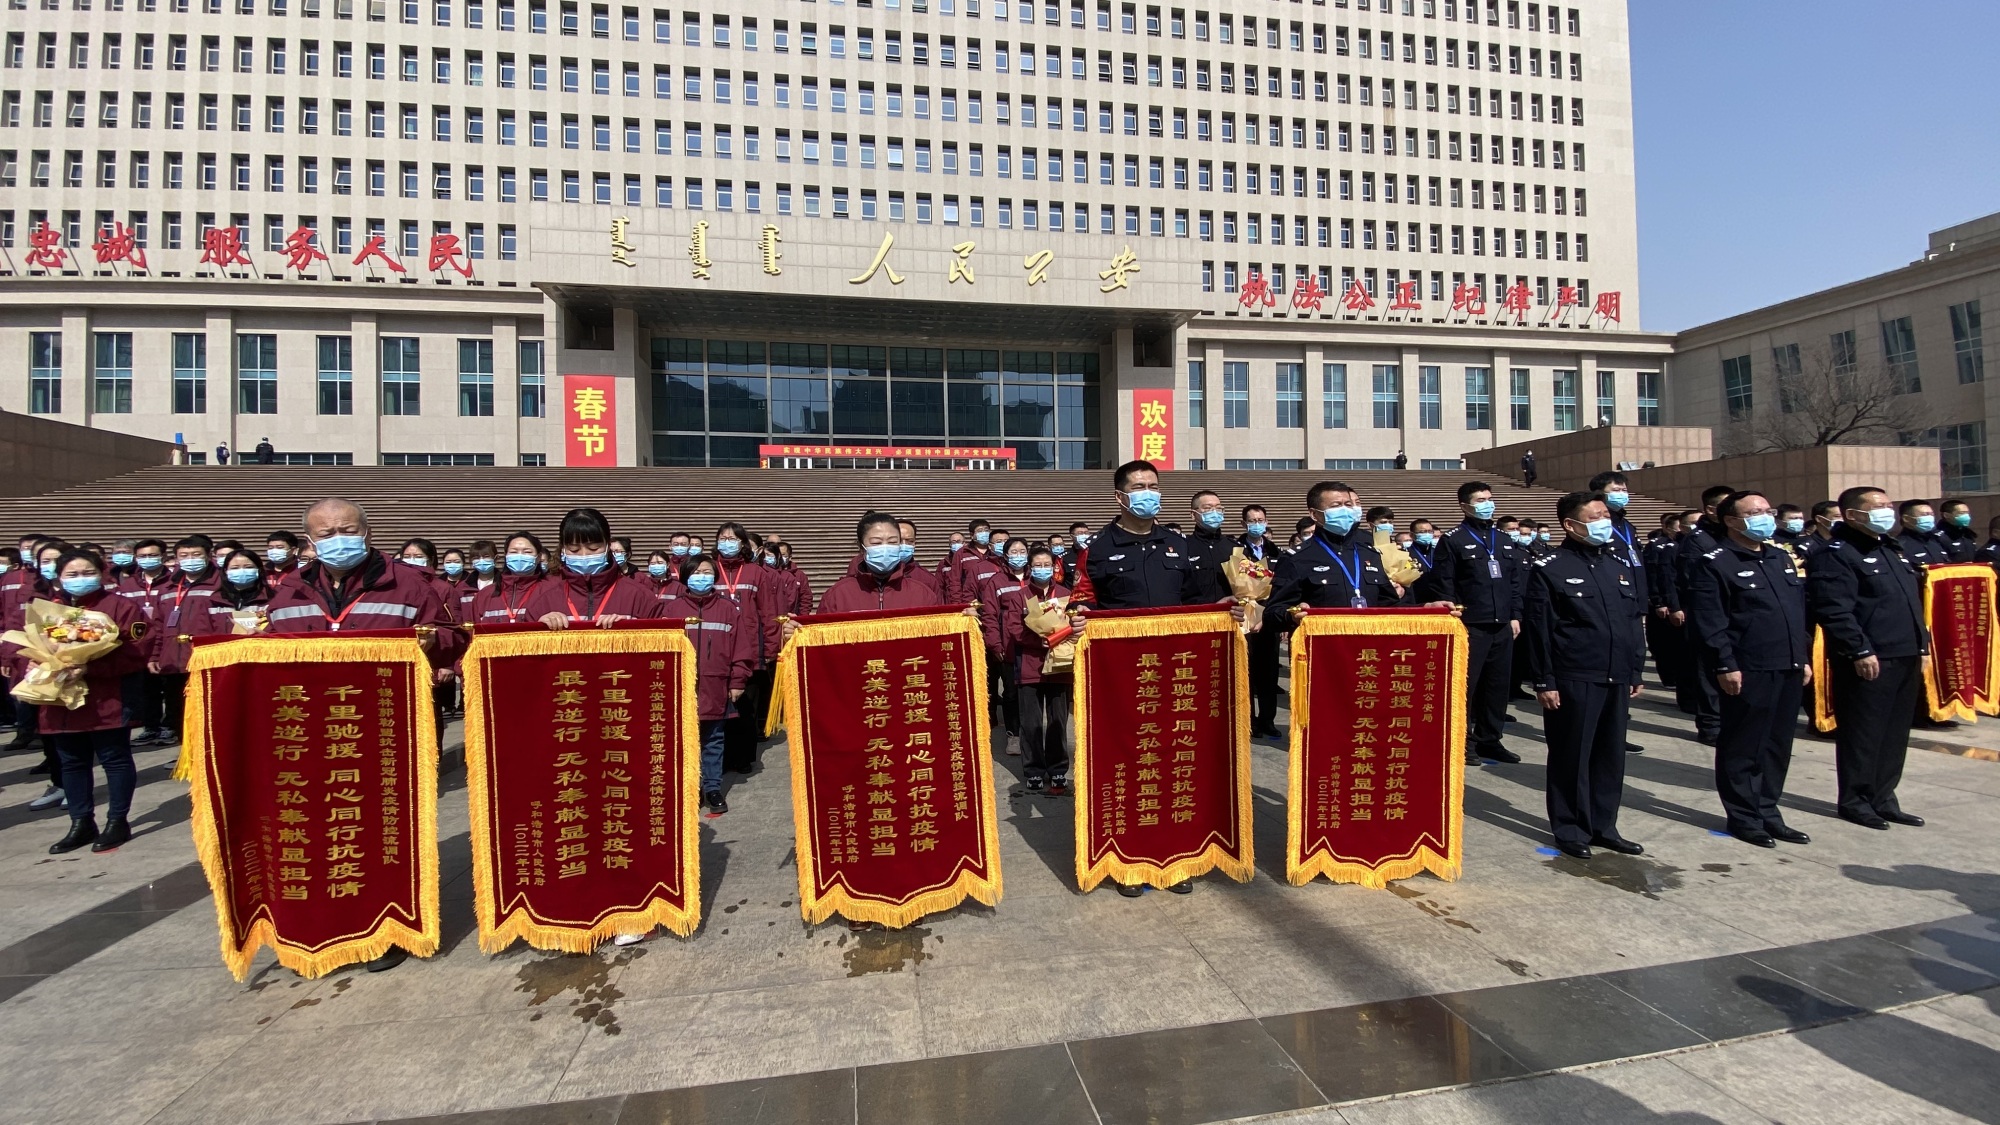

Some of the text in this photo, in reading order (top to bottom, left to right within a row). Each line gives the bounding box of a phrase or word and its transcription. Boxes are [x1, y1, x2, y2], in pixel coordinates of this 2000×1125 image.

[26, 222, 472, 277] 忠诚 服务人民
[848, 231, 1140, 292] 人民公安
[1240, 273, 1620, 321] 执法公正 纪律严明
[573, 387, 608, 456] 春节
[1140, 400, 1167, 461] 欢度
[552, 751, 590, 879] 无私奉献显担当
[601, 750, 634, 870] 同心同行抗疫情
[864, 737, 898, 857] 无私奉献显担当
[905, 731, 939, 853] 同心同行抗疫情
[1136, 722, 1163, 827] 无私奉献显担当
[1171, 719, 1198, 823] 同心同行抗疫情
[1349, 717, 1379, 821] 无私奉献显担当
[1383, 716, 1412, 821] 同心同行抗疫情
[274, 771, 313, 901] 无私奉献显担当
[324, 768, 366, 899] 同心同行抗疫情
